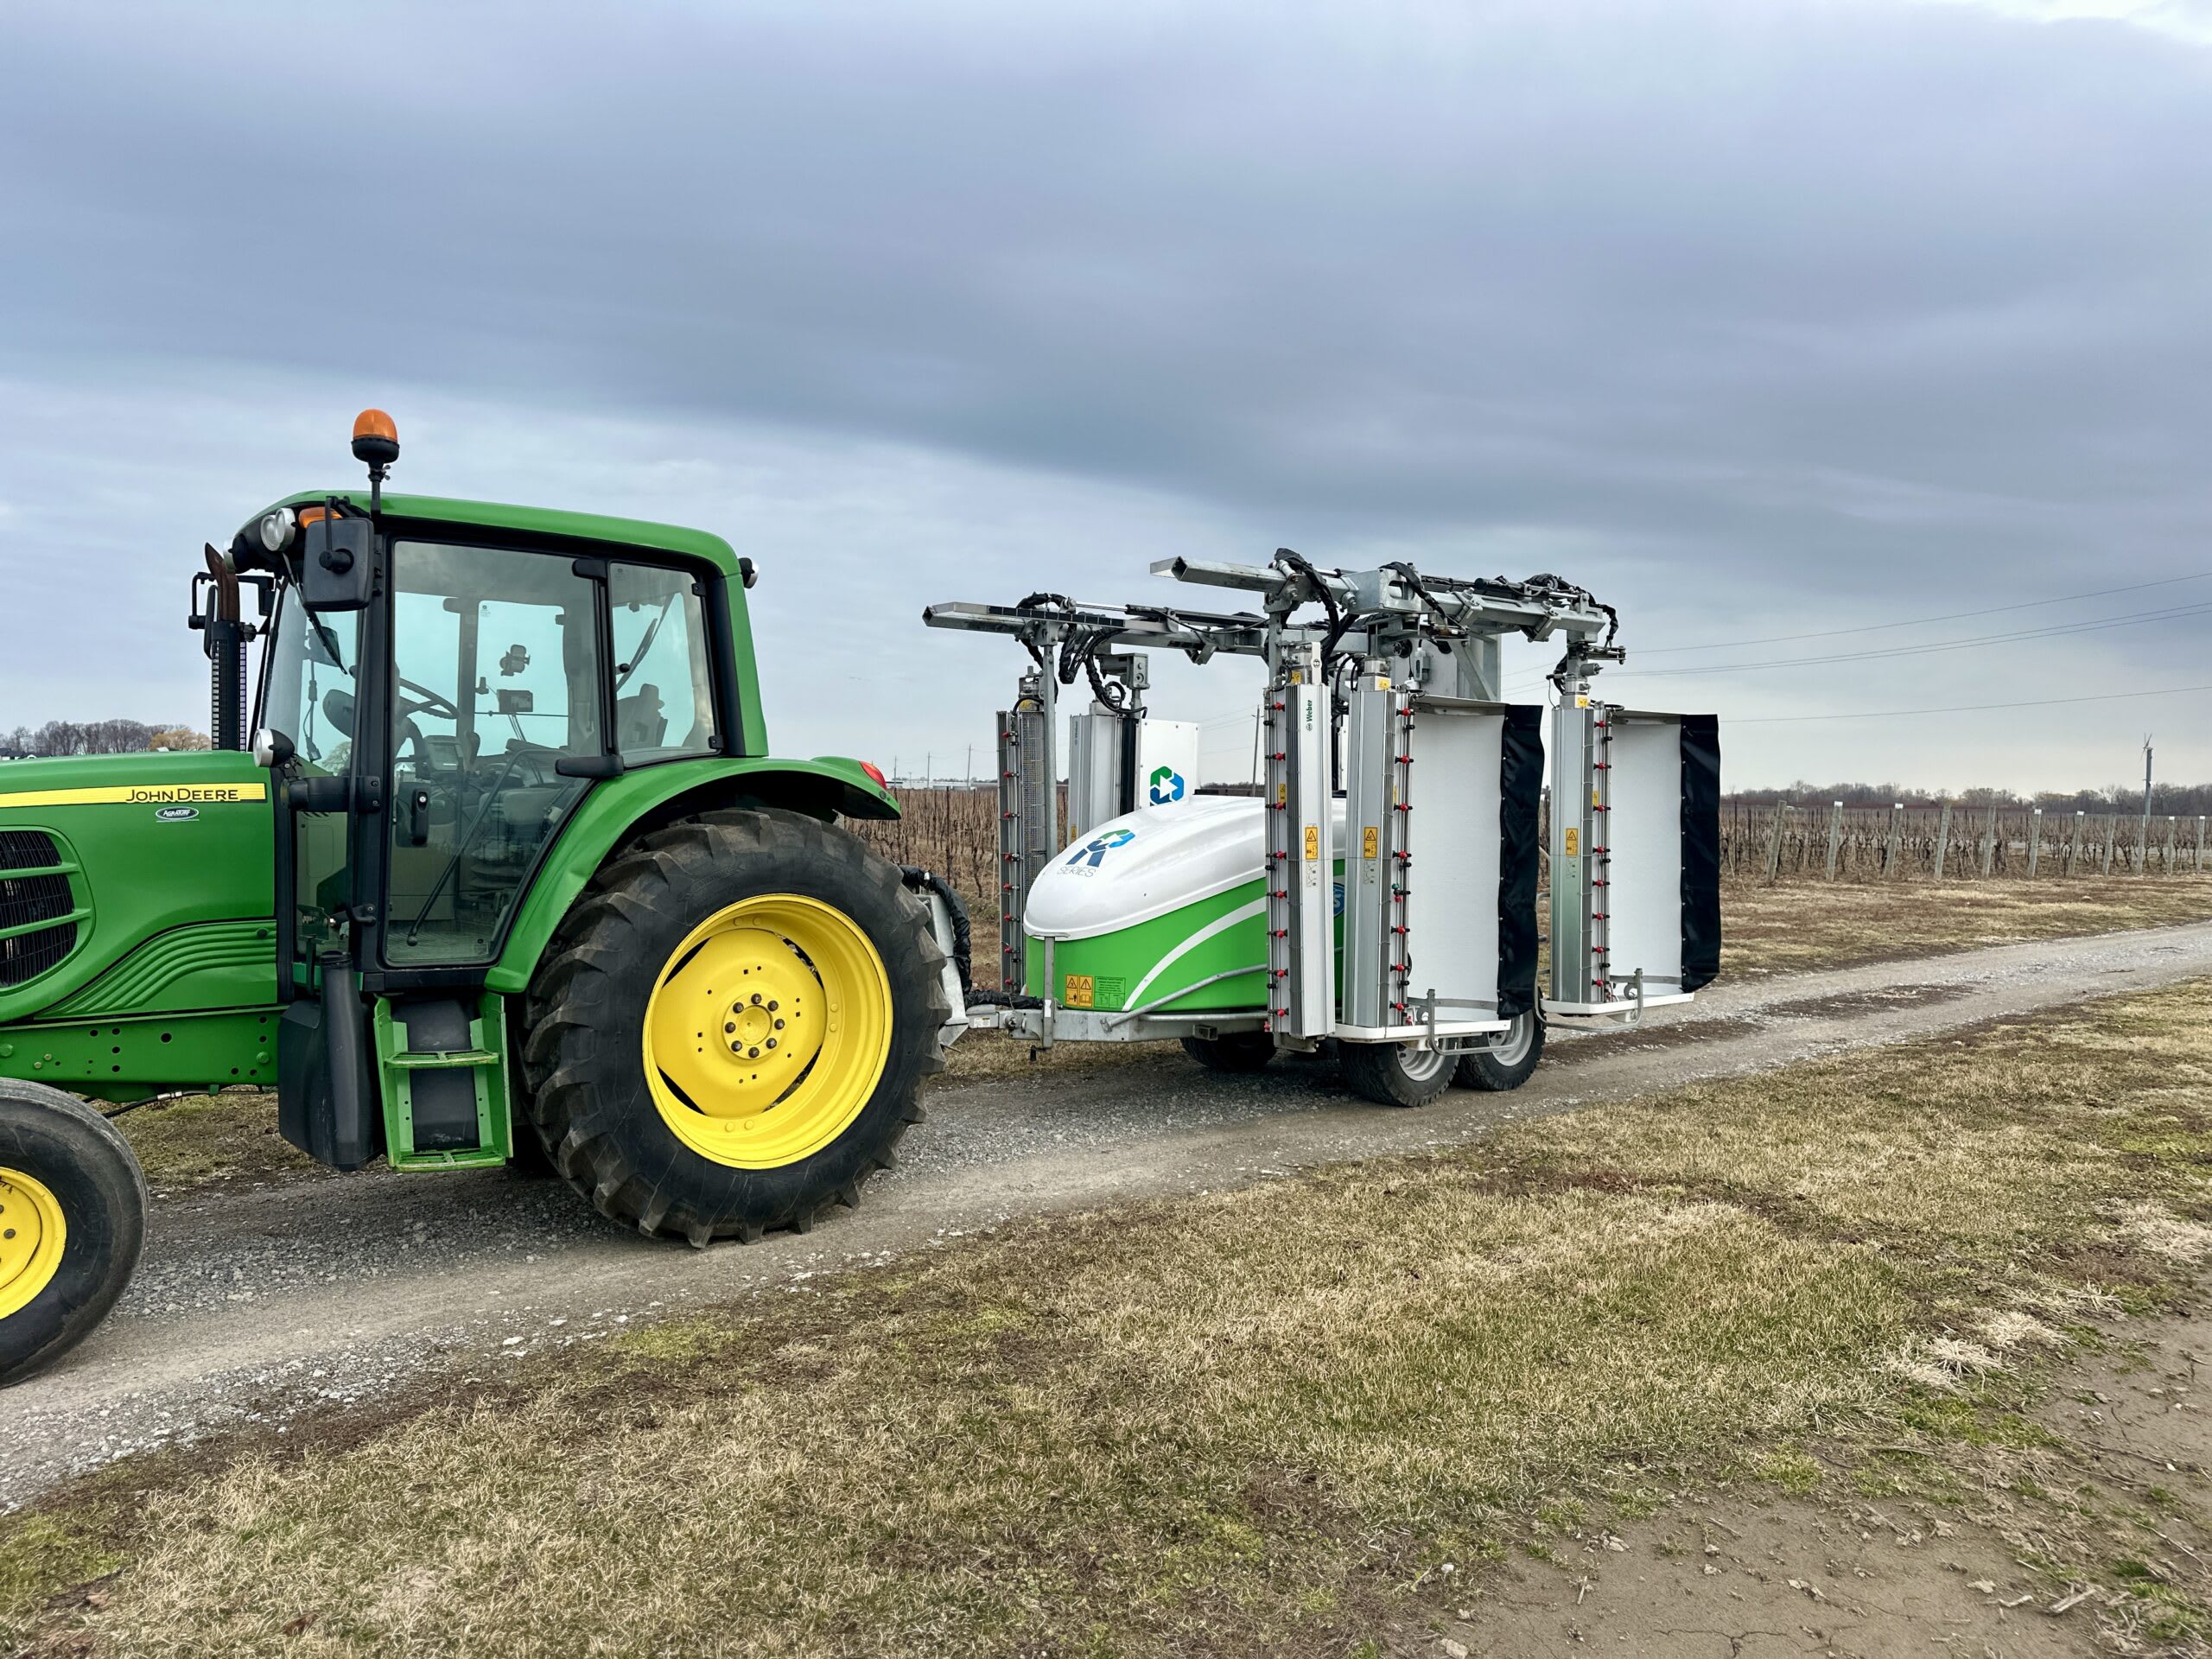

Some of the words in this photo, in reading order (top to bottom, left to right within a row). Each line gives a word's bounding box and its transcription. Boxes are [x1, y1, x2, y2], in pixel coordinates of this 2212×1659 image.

[126, 790, 174, 802] JOHN
[177, 788, 238, 801] DEERE
[1057, 866, 1096, 878] SERIES
